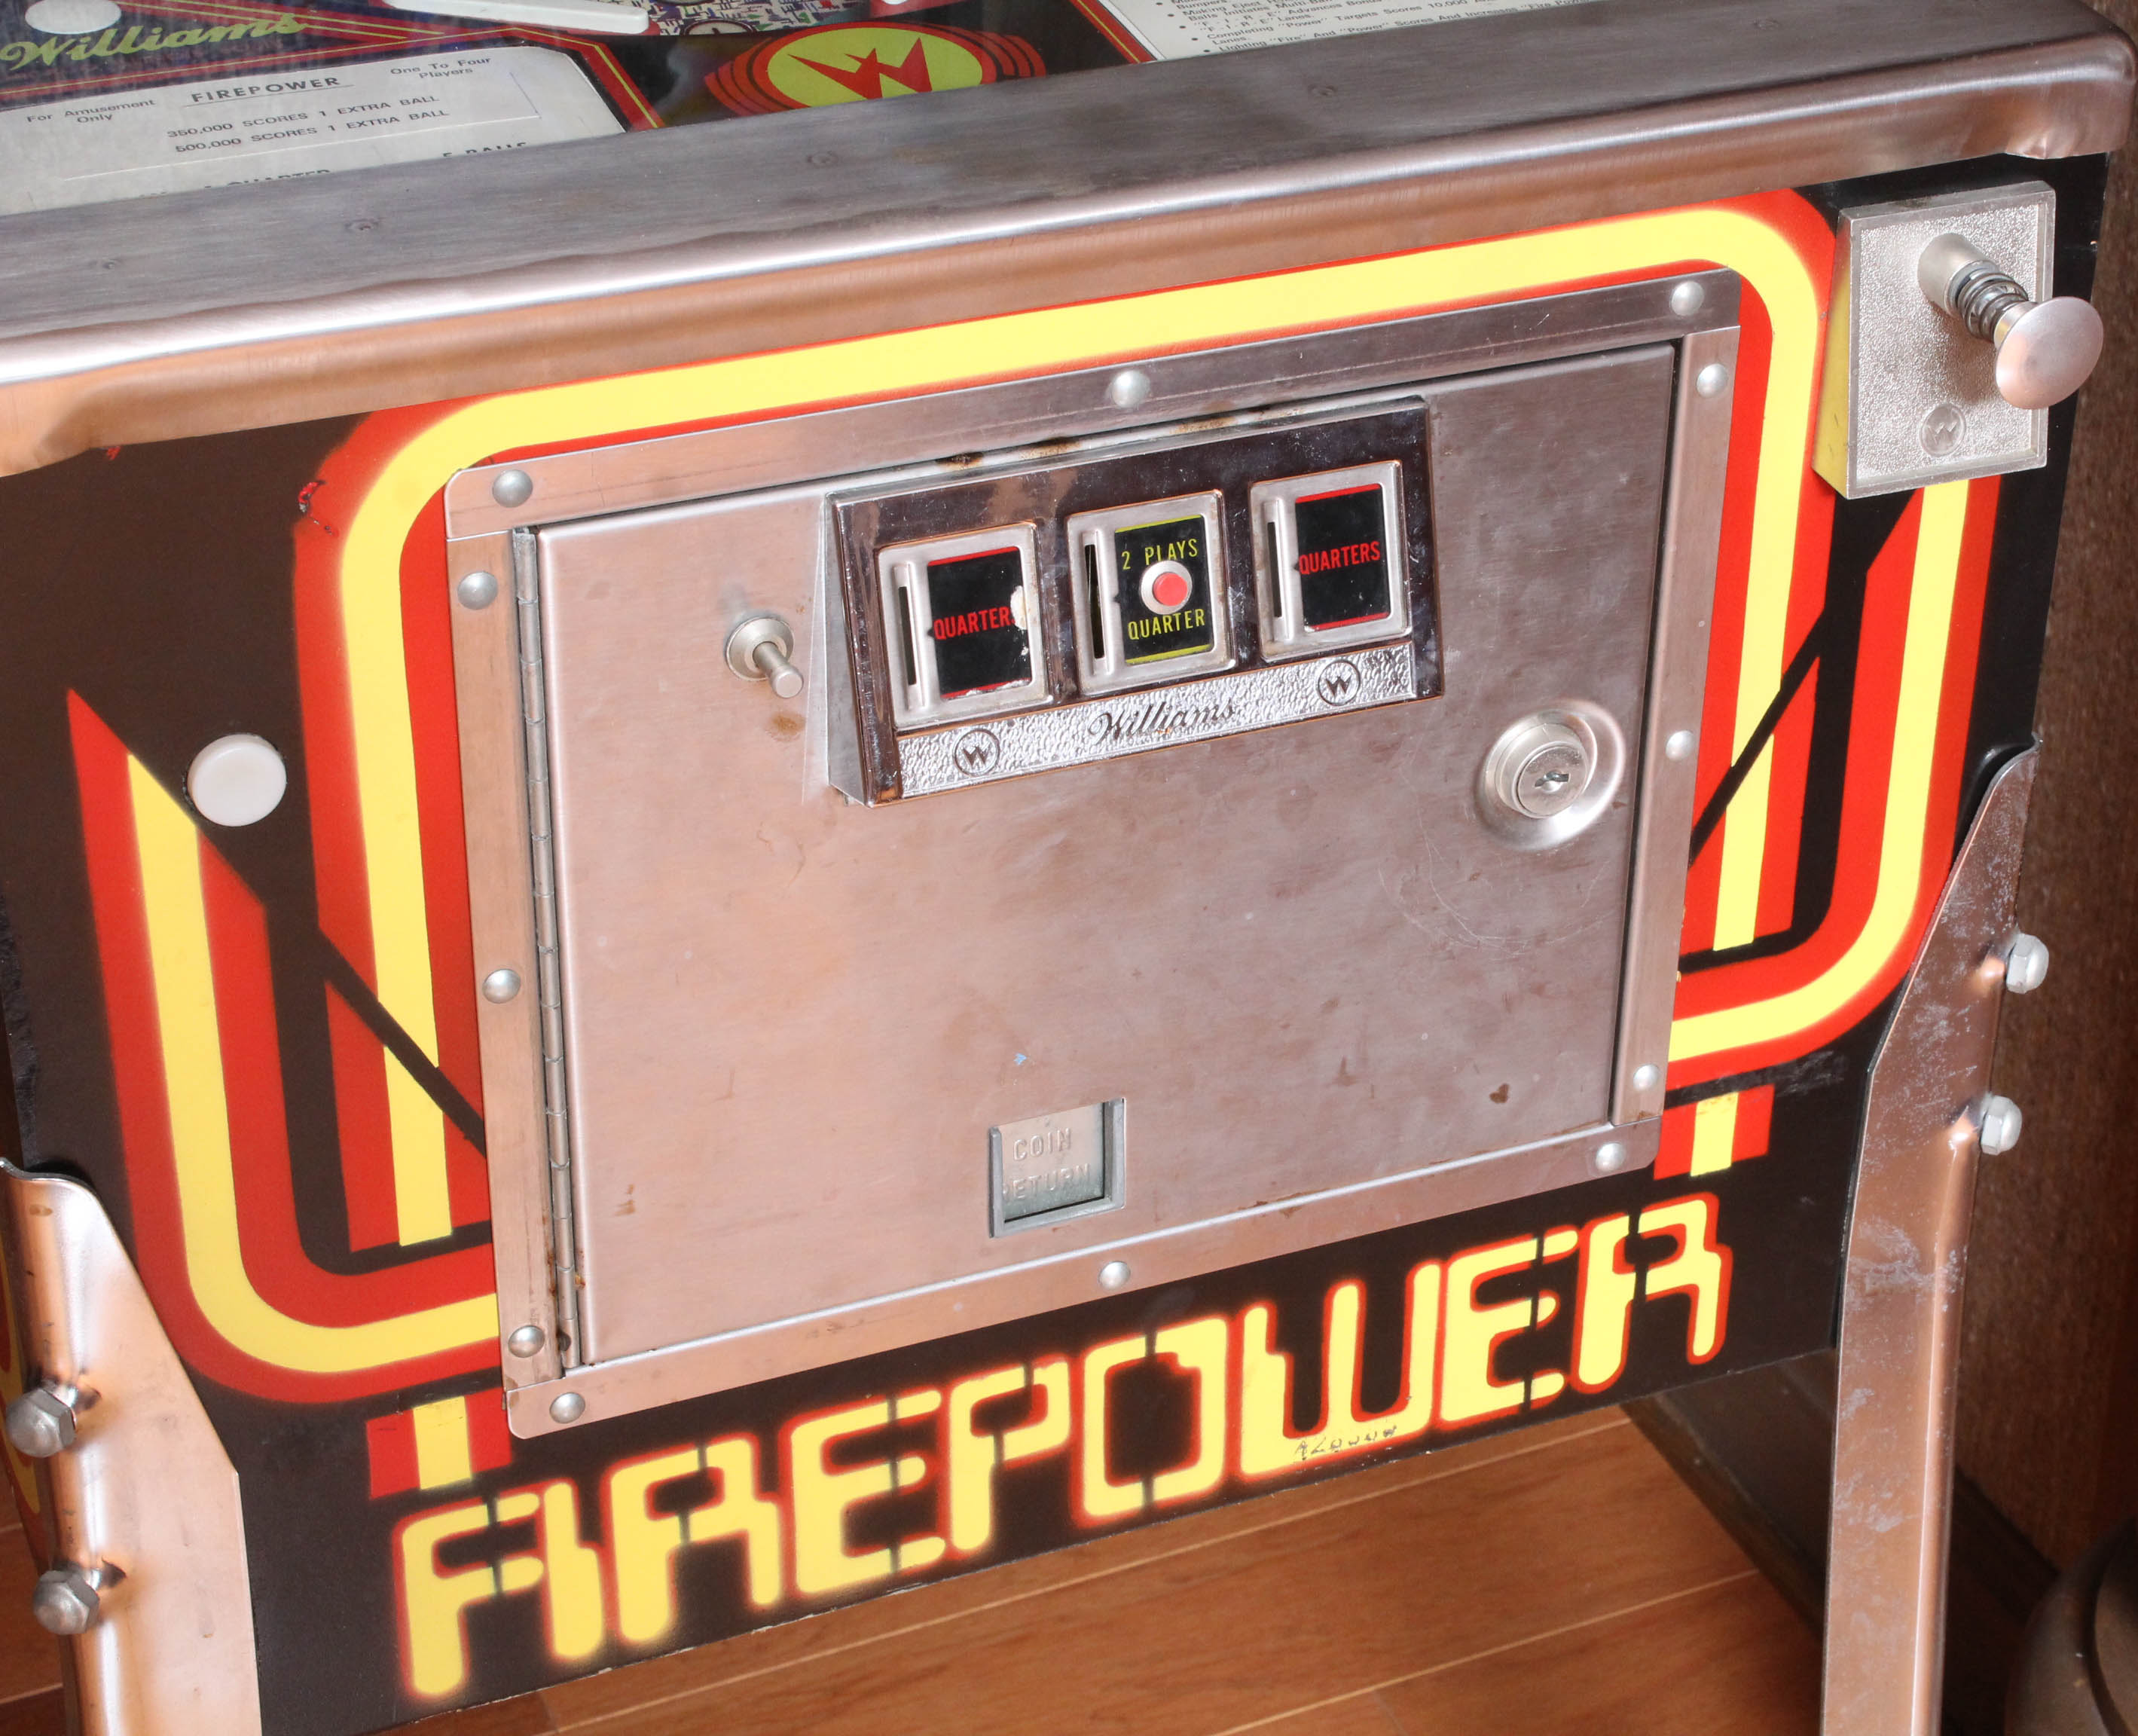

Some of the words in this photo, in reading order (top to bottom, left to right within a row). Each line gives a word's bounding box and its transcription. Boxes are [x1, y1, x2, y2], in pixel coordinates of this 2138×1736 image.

[1182, 7, 1227, 16] Making
[1207, 26, 1274, 38] Completing
[1334, 12, 1379, 20] Targets
[1384, 6, 1422, 14] Scores
[1223, 7, 1271, 16] Initiates
[1288, 4, 1342, 14] Advances
[0, 13, 310, 71] Williams
[1219, 41, 1267, 52] Lighting
[390, 66, 420, 75] One
[427, 63, 449, 71] To
[457, 58, 491, 66] Four
[419, 68, 474, 79] Players
[191, 77, 341, 102] FIREPOWER
[26, 113, 53, 123] For
[63, 99, 156, 118] Amusement
[77, 113, 114, 124] Only
[166, 123, 233, 138] 350,000
[242, 112, 308, 127] SCORES
[337, 102, 391, 115] EXTRA
[399, 96, 440, 105] BALL
[175, 138, 242, 152] 500,000
[251, 127, 318, 142] SCORES
[347, 116, 400, 129] EXTRA
[408, 110, 450, 121] BALL
[1121, 551, 1132, 570] 2
[1299, 540, 1381, 575] QUARTERS
[933, 606, 1016, 640] QUARTER
[1127, 608, 1205, 640] QUARTER
[1086, 701, 1235, 746] Williams
[1012, 1127, 1071, 1161] COIN
[393, 1192, 1733, 1701] FIREPOWER
